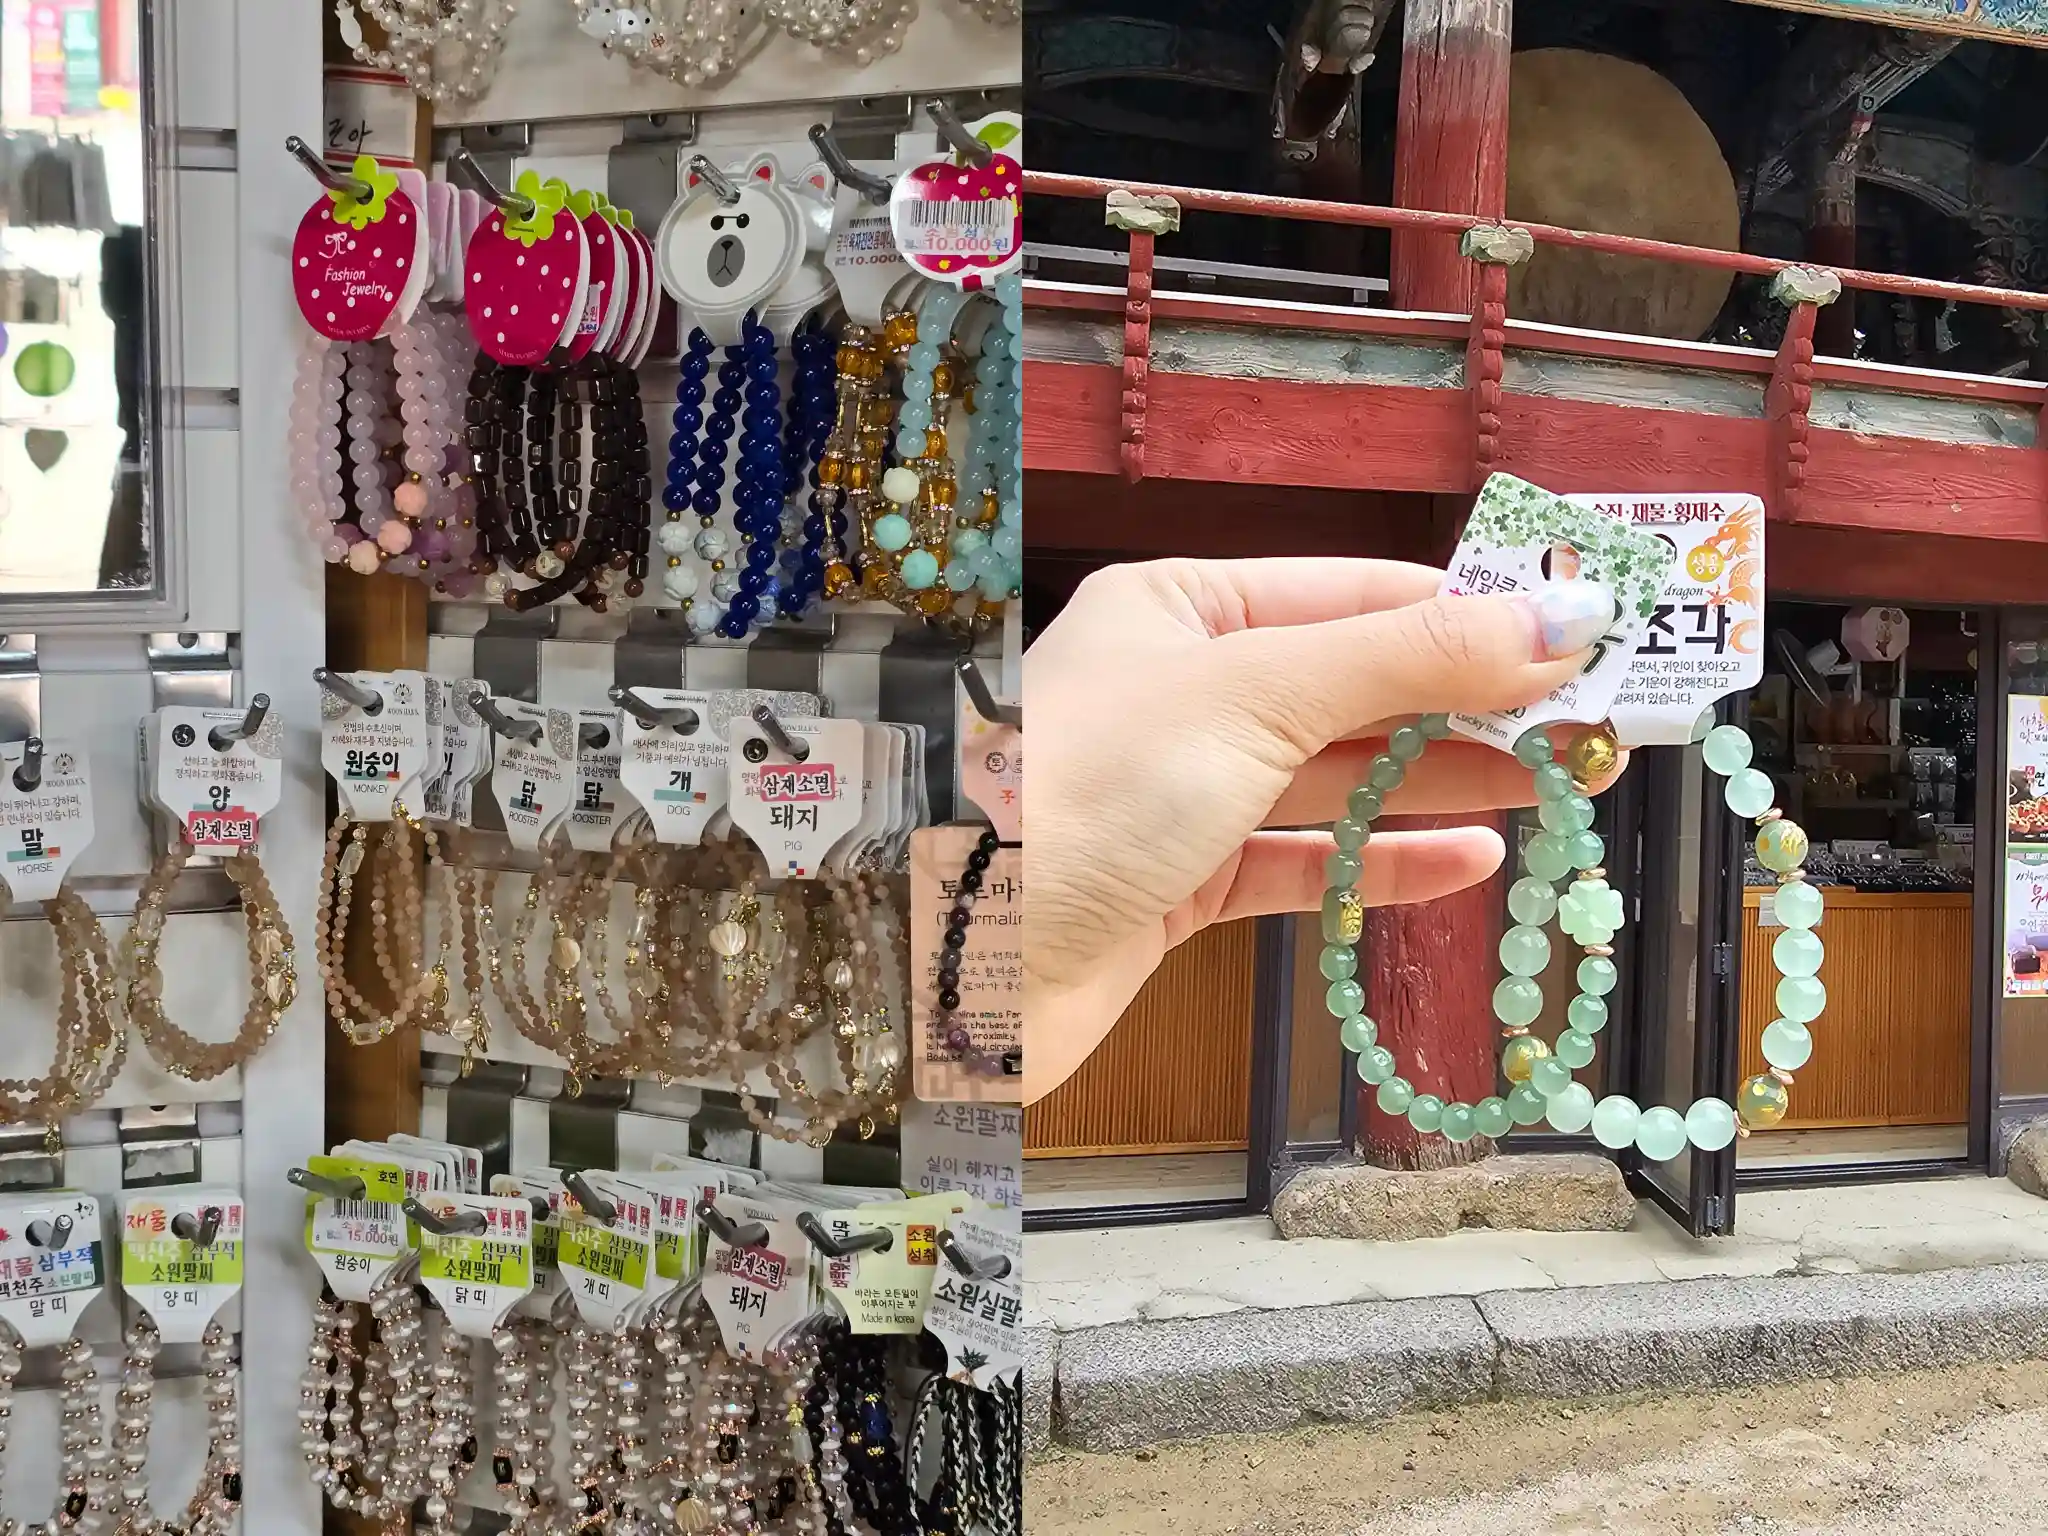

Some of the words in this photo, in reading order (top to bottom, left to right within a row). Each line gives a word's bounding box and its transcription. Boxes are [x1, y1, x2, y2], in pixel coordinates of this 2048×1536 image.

[927, 238, 1009, 252] 10.000원
[325, 265, 366, 281] Fashion
[342, 281, 388, 300] Jewelry
[1664, 583, 1704, 600] dragon
[1662, 661, 1694, 673] 귀인이
[1697, 661, 1741, 673] 찾아오고
[1640, 676, 1671, 689] 기운이
[1674, 676, 1729, 689] 강해진다고
[1647, 692, 1694, 705] 있습니다.
[345, 749, 399, 778] 원숭이
[353, 784, 389, 794] MONKEY
[669, 771, 692, 792] 개
[763, 773, 831, 796] 삼재소멸
[208, 785, 231, 811] 양
[521, 780, 537, 808] 닭
[583, 782, 604, 808] 닭
[508, 811, 539, 826] ROOSTER
[667, 805, 691, 815] DOG
[770, 804, 818, 832] 돼지
[192, 819, 252, 841] 삼재소멸
[21, 828, 44, 857] 말
[784, 841, 803, 851] PIG
[16, 862, 54, 875] HORSE
[971, 1021, 986, 1029] the
[989, 1021, 1010, 1029] best
[972, 1032, 1015, 1041] proximity
[926, 1052, 949, 1063] Body
[378, 1170, 398, 1184] 호연
[926, 1155, 957, 1175] 실이
[966, 1160, 1016, 1182] 헤지고
[127, 1209, 167, 1231] 재물
[348, 1229, 399, 1246] 15.000원
[907, 1228, 936, 1243] 소원
[481, 1241, 522, 1264] 삼부적
[608, 1233, 644, 1264] 삼부적
[908, 1247, 937, 1264] 성취
[38, 1246, 94, 1272] 삼부적
[334, 1254, 371, 1274] 원숭이
[732, 1248, 780, 1284] 삼재소멸
[456, 1286, 469, 1304] 닭
[473, 1289, 486, 1305] 띠
[584, 1278, 596, 1295] 개
[598, 1282, 610, 1300] 띠
[855, 1289, 880, 1299] 바라는
[30, 1299, 46, 1318] 말
[51, 1296, 67, 1314] 띠
[163, 1291, 178, 1308] 양
[184, 1290, 198, 1306] 띠
[729, 1285, 768, 1318] 돼지
[861, 1299, 904, 1310] 이루어지는
[861, 1312, 883, 1323] Made
[885, 1313, 892, 1323] in
[894, 1312, 915, 1324] korea
